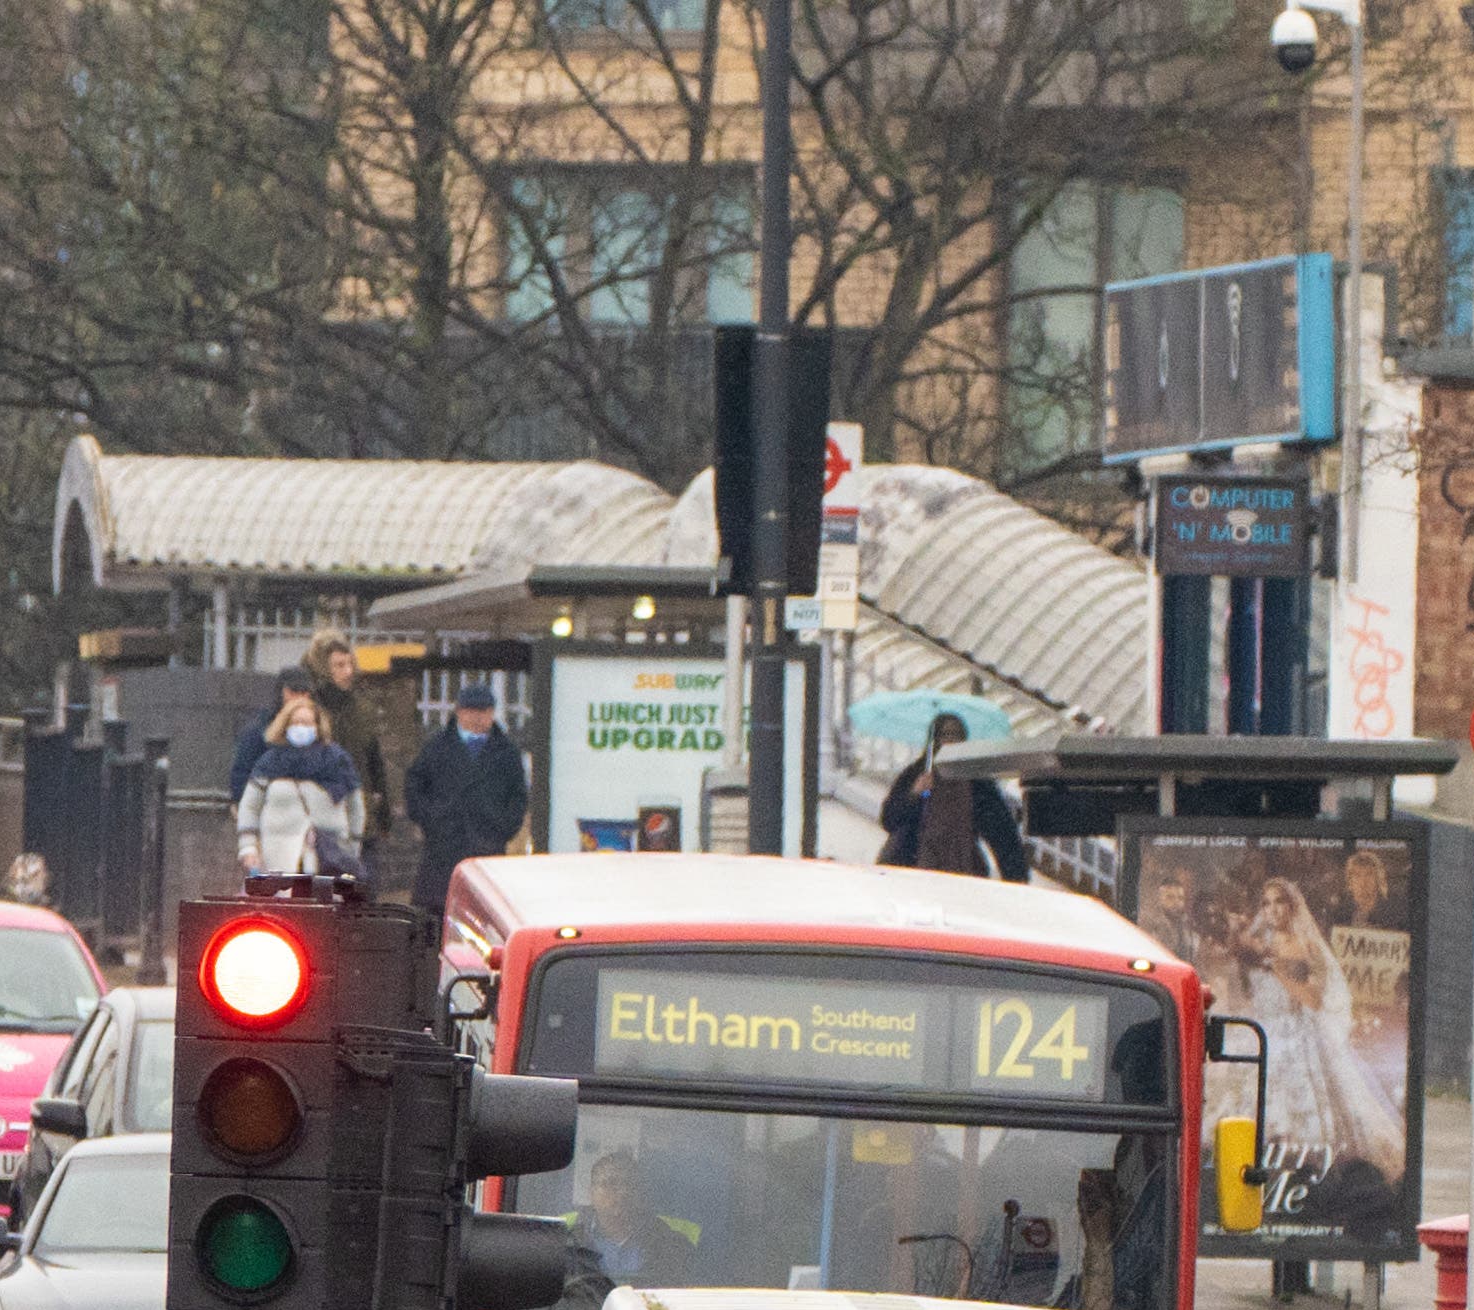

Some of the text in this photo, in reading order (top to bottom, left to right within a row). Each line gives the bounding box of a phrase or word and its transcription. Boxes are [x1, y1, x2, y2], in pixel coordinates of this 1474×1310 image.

[1170, 486, 1295, 510] COMPUTER
[1209, 521, 1294, 545] MOBILE
[632, 673, 725, 691] SUBWAY
[587, 702, 663, 724] LUNCH
[667, 703, 719, 725] JUST
[587, 728, 739, 751] UPGRAD
[609, 991, 1089, 1081] Eltham Southend 124
[811, 1031, 912, 1059] Crescent
